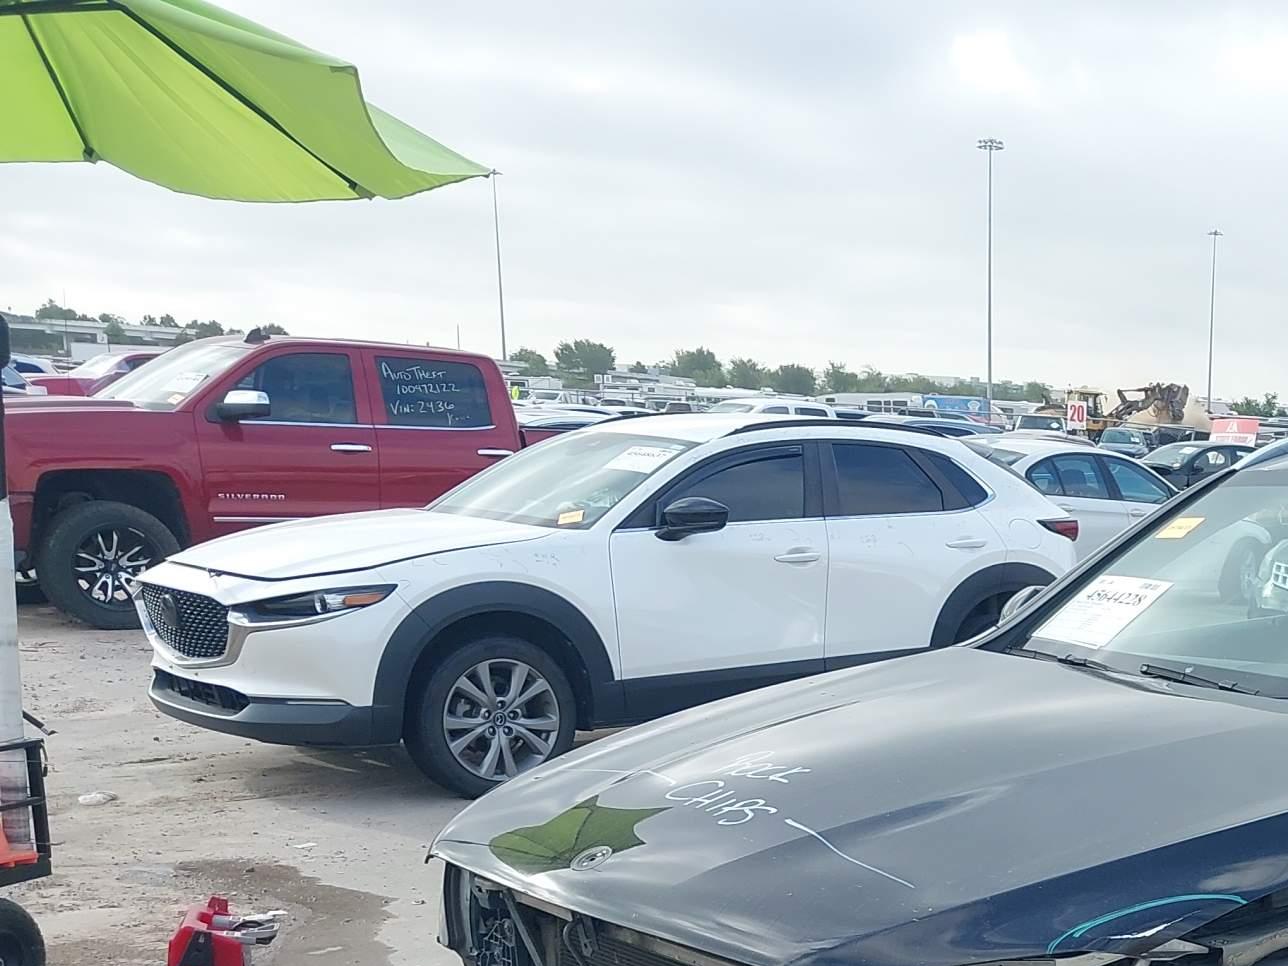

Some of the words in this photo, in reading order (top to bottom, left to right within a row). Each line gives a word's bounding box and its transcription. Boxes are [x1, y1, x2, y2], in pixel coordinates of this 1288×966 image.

[418, 400, 455, 413] 2436
[1070, 404, 1085, 423] 20
[664, 779, 779, 826] CHIPS
